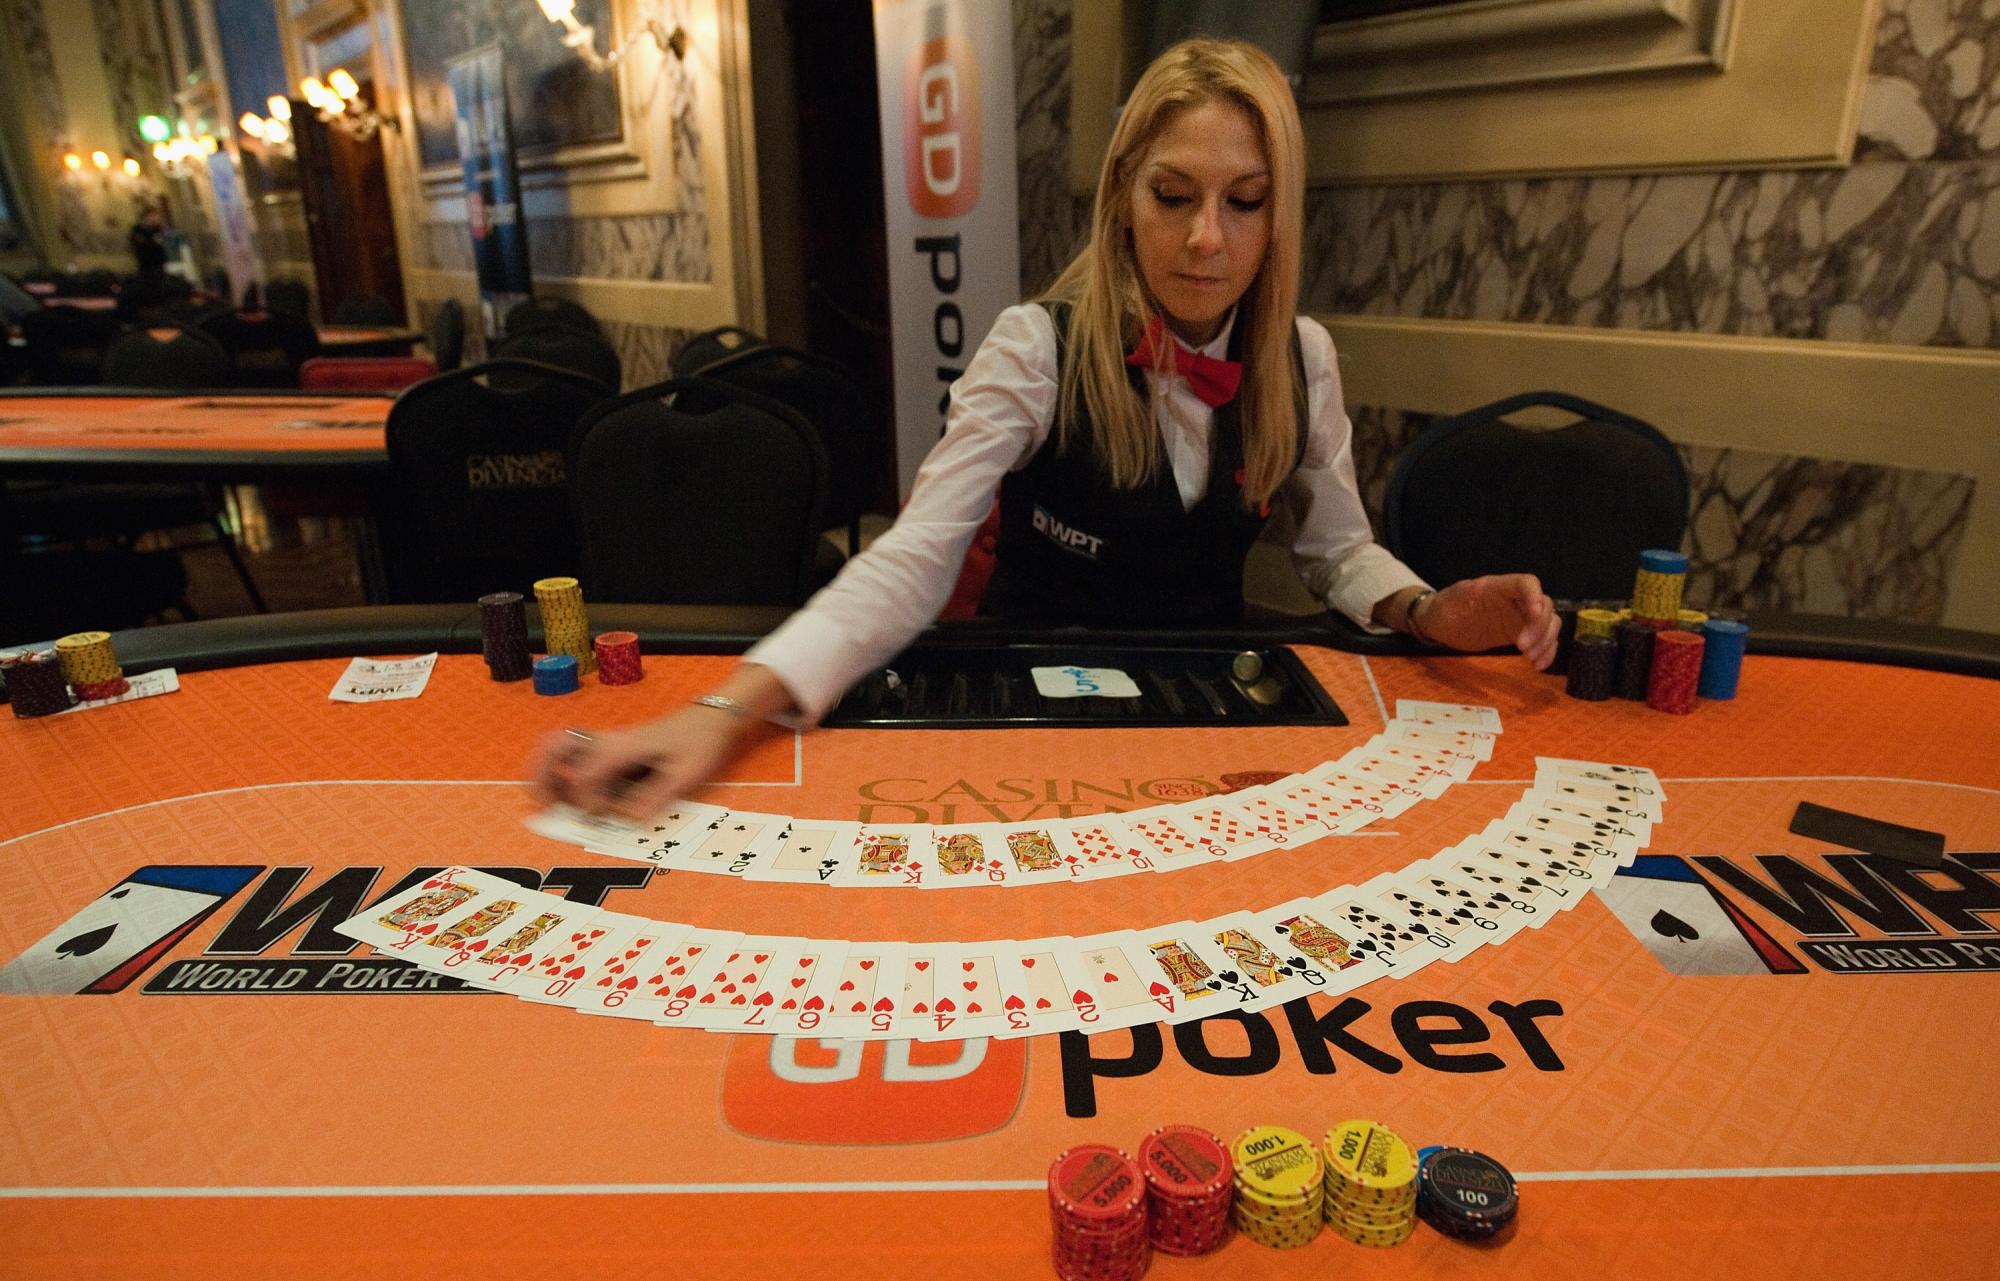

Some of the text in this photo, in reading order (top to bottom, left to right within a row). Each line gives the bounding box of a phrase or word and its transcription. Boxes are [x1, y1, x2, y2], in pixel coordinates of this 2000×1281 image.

[918, 62, 962, 196] GD
[1050, 516, 1104, 554] WPT
[1402, 787, 1422, 797] 5
[1632, 786, 1655, 796] 2
[1625, 809, 1648, 820] 3
[1320, 819, 1340, 831] 7
[1612, 826, 1636, 837] 4
[1267, 832, 1288, 844] 8
[646, 848, 669, 861] 3
[1593, 847, 1618, 859] 5
[729, 860, 750, 873] 2
[1069, 864, 1085, 877] J
[1131, 856, 1155, 869] 10
[436, 867, 467, 882] K
[817, 868, 836, 881] A
[903, 871, 924, 884] K
[988, 868, 1008, 883] Q
[1543, 885, 1569, 897] 7
[1688, 851, 2000, 938] WP
[200, 865, 657, 955] WT
[1511, 900, 1537, 914] 8
[389, 932, 424, 951] K
[1426, 931, 1457, 949] 10
[443, 948, 471, 967] Q
[1375, 950, 1397, 969] J
[1811, 943, 1958, 969] WORLD
[167, 962, 443, 990] WORLD POKER
[488, 966, 519, 982] J
[1296, 968, 1327, 986] Q
[544, 978, 577, 998] 10
[1227, 981, 1260, 1003] K
[663, 999, 690, 1017] 8
[1077, 1003, 1100, 1023] 2
[1152, 995, 1176, 1014] A
[743, 1007, 766, 1026] 7
[871, 1013, 893, 1031] 5
[933, 1013, 957, 1032] 4
[1007, 1011, 1031, 1030] 3
[1059, 994, 1566, 1119] poker
[1245, 1135, 1286, 1156] 1.000
[1339, 1130, 1363, 1161] 1.000
[1150, 1149, 1189, 1185] 5.000
[1455, 1188, 1489, 1207] 100
